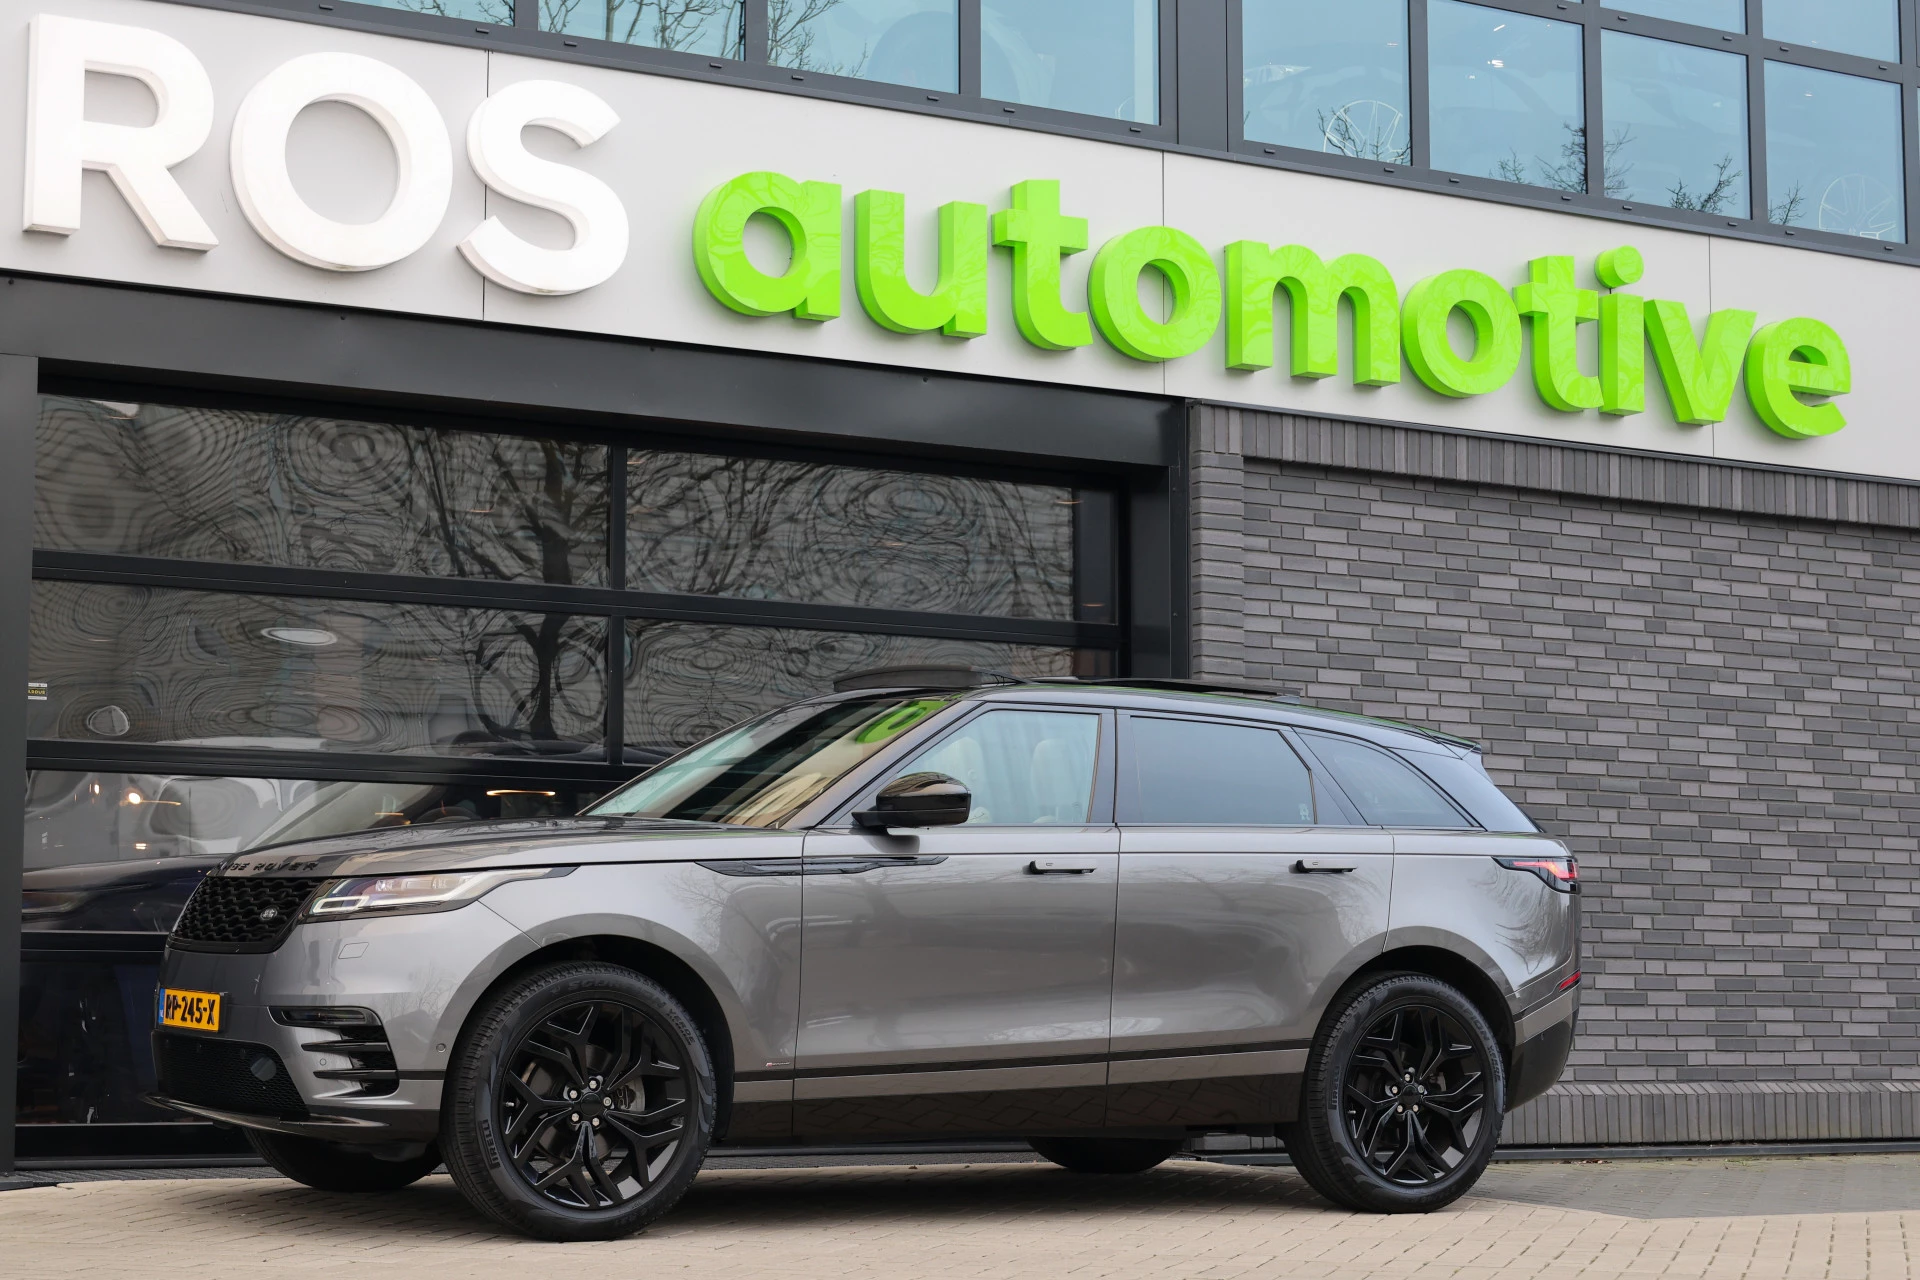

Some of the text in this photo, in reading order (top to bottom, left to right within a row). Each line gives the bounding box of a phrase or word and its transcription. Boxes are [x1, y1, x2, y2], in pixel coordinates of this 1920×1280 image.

[23, 13, 1851, 439] ROS automotive
[253, 862, 319, 871] ROVER
[165, 994, 216, 1025] RP-245-X
[477, 1119, 501, 1170] PIRELLI
